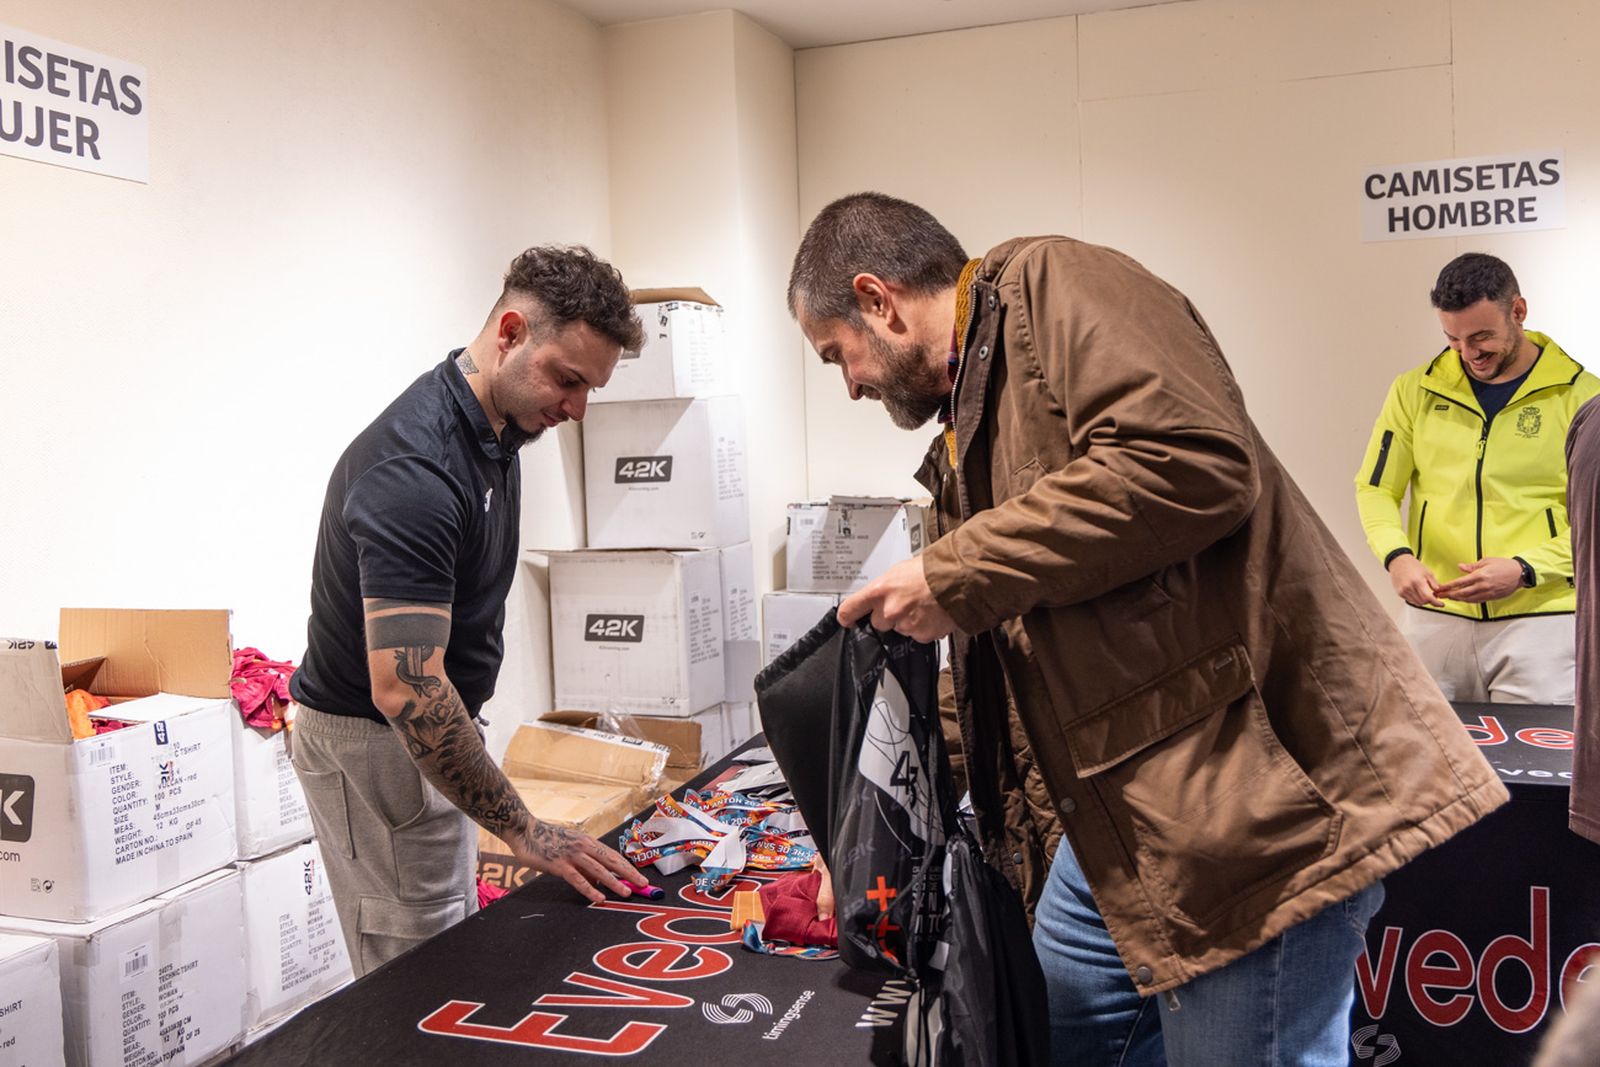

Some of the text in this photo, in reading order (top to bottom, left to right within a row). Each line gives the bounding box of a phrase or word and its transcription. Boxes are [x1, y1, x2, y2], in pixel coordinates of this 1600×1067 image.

[5, 40, 143, 116] ISETAS
[0, 98, 101, 161] UJER
[1364, 158, 1561, 200] CAMISETAS
[1387, 196, 1538, 233] HOMBRE
[618, 460, 668, 479] 42K
[588, 618, 639, 638] 42K
[180, 743, 201, 756] TSHIRT
[110, 774, 134, 785] STYLE:
[111, 780, 141, 795] GENDER:
[112, 787, 181, 815] QUANTITY: 100 PCS
[712, 796, 743, 808] ANTON
[114, 814, 128, 825] SIZE
[114, 822, 135, 835] MEAS:
[114, 829, 143, 845] WEIGHT:
[169, 818, 178, 826] KG
[115, 838, 143, 855] CARTON
[186, 822, 193, 830] OF
[115, 832, 193, 865] MADE IN CHINA TO SPAIN
[303, 859, 312, 896] 42K
[479, 862, 530, 888] 2K
[696, 878, 709, 887] DE
[762, 990, 816, 1040] timingsense
